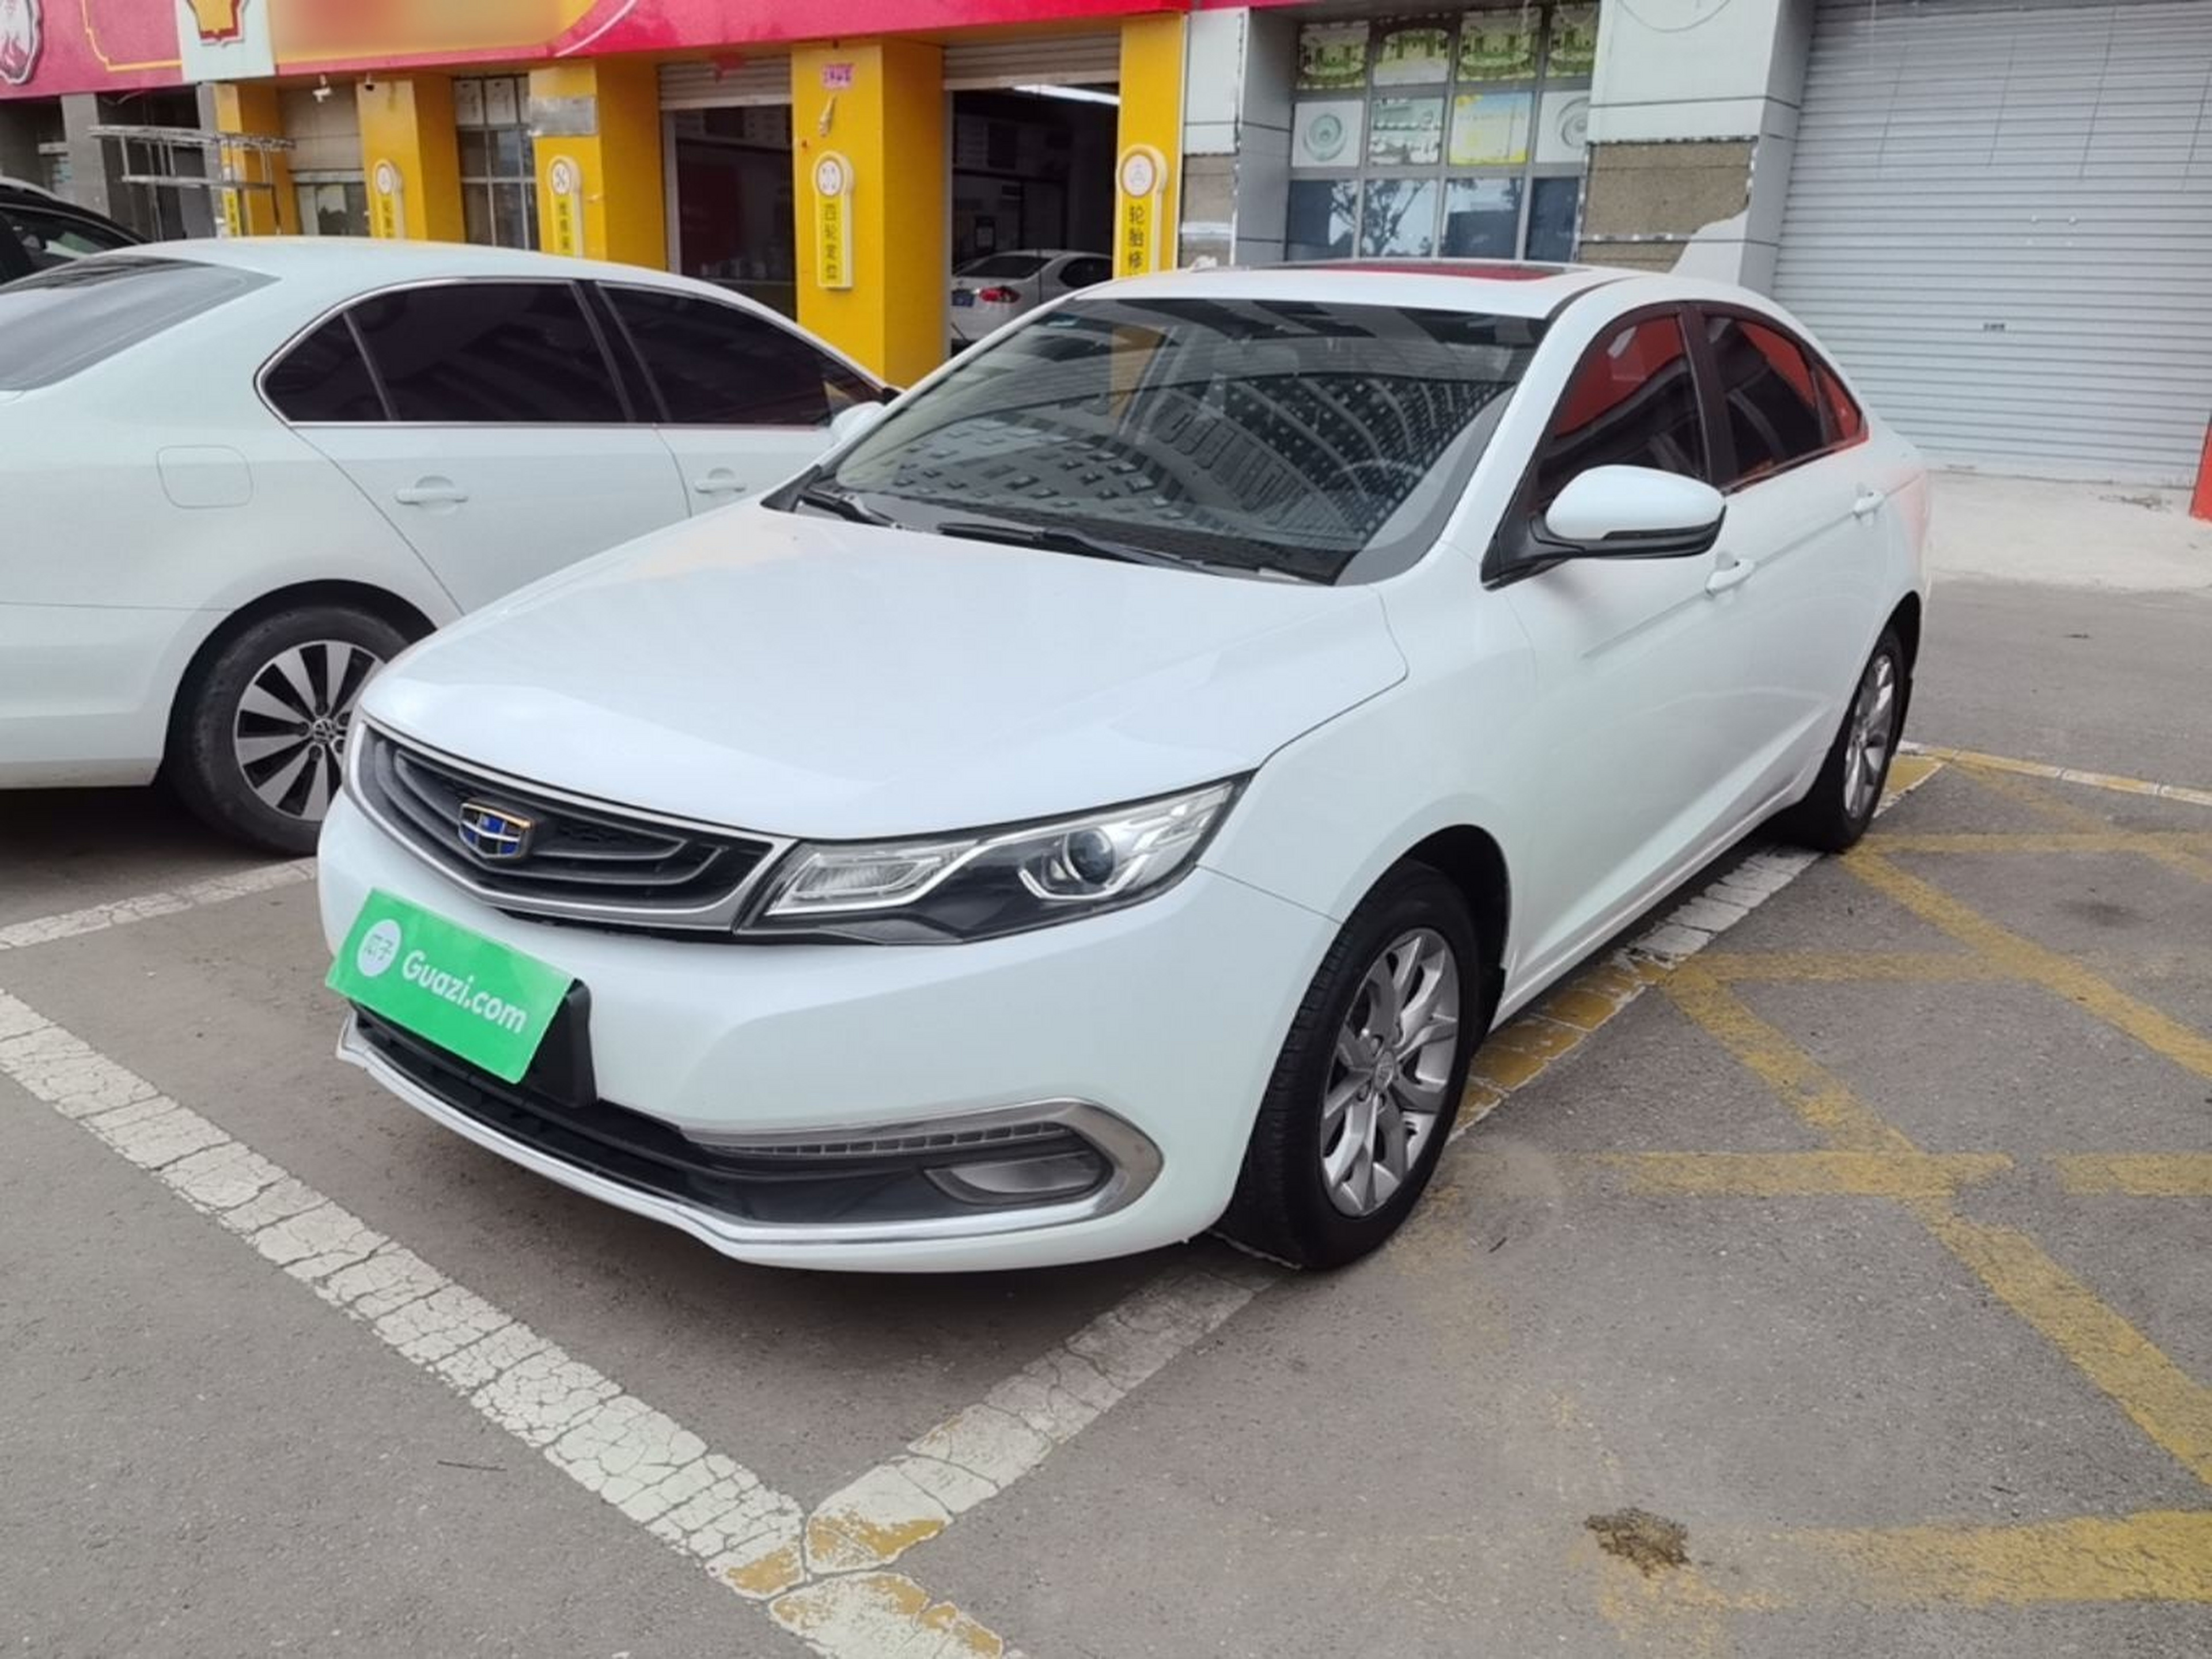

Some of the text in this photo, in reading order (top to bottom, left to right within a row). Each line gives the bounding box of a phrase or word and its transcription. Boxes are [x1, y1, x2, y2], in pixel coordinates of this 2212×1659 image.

[1129, 204, 1145, 275] 轮胎修
[403, 950, 527, 1033] Guazi.com
